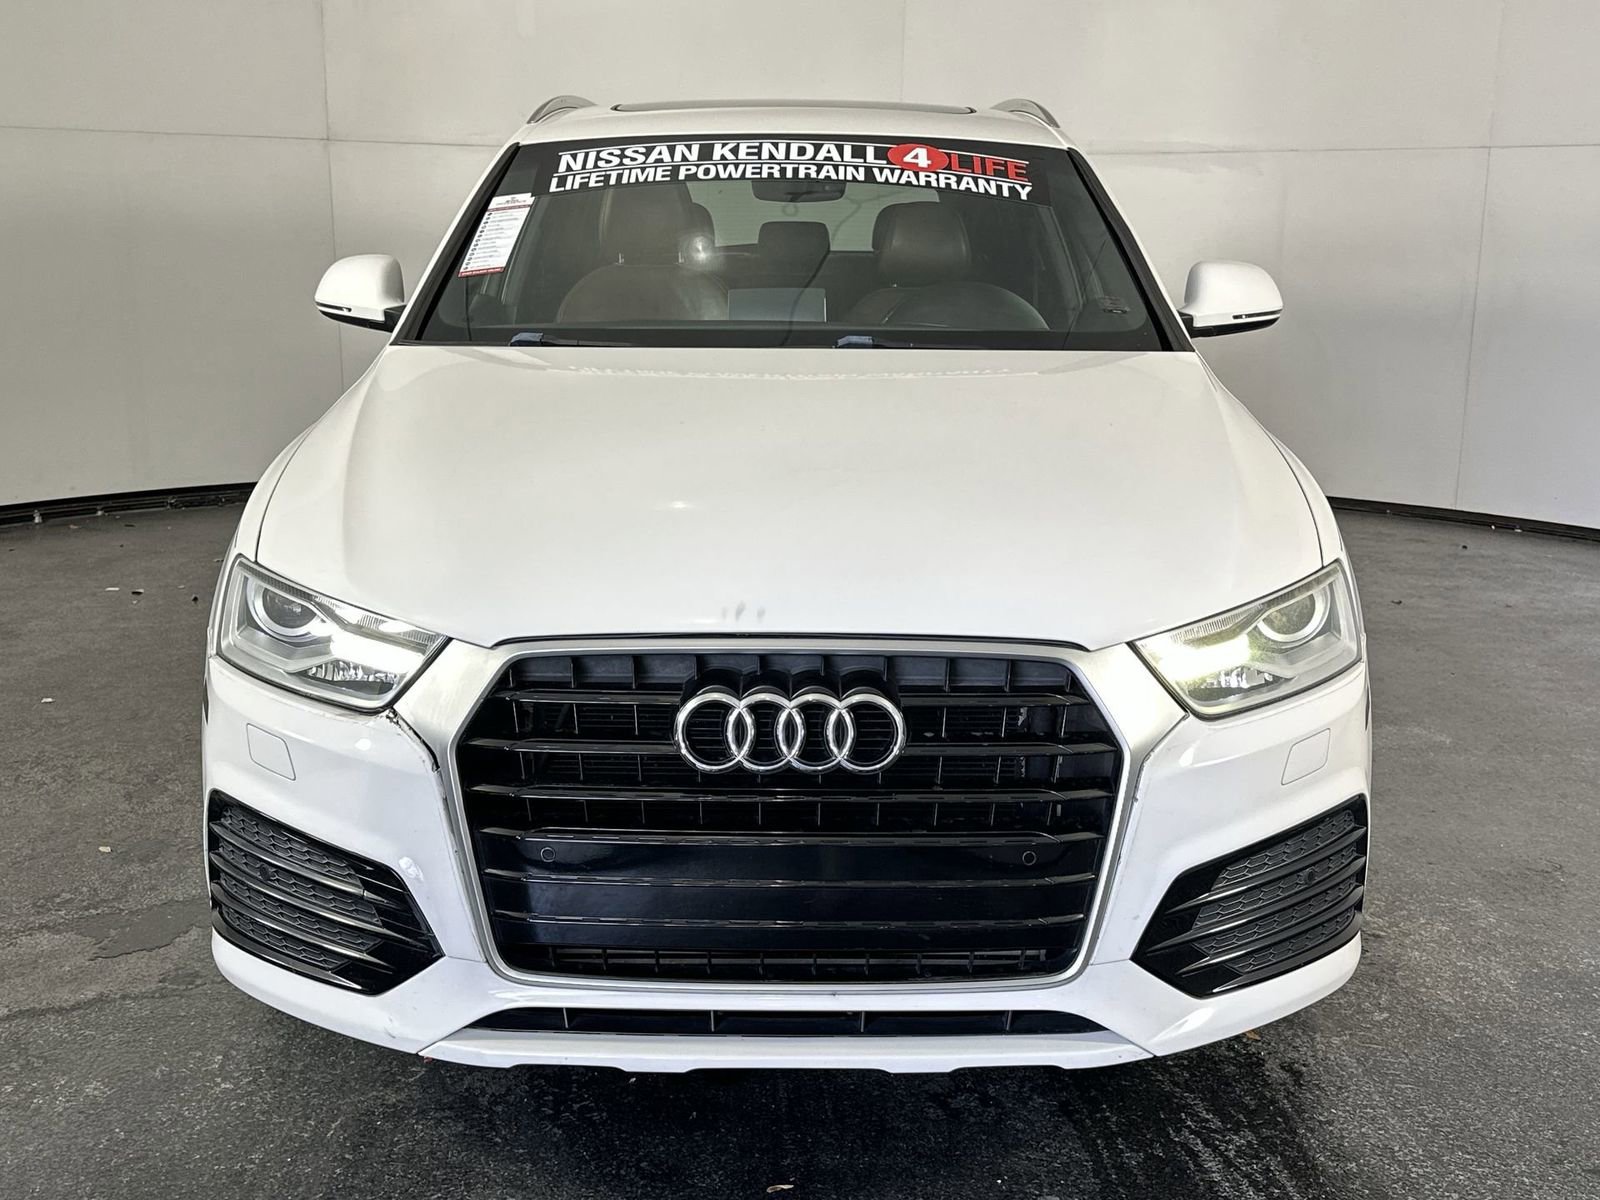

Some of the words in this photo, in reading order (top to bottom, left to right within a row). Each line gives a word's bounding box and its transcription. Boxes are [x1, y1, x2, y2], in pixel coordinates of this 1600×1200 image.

[558, 143, 700, 173] NISSAN
[712, 142, 888, 165] KENDALL
[903, 147, 932, 168] 4
[949, 153, 1029, 182] LIFE
[549, 166, 672, 193] LIFETIME
[678, 163, 866, 181] POWERTRAIN
[872, 167, 1033, 200] WARRANTY
